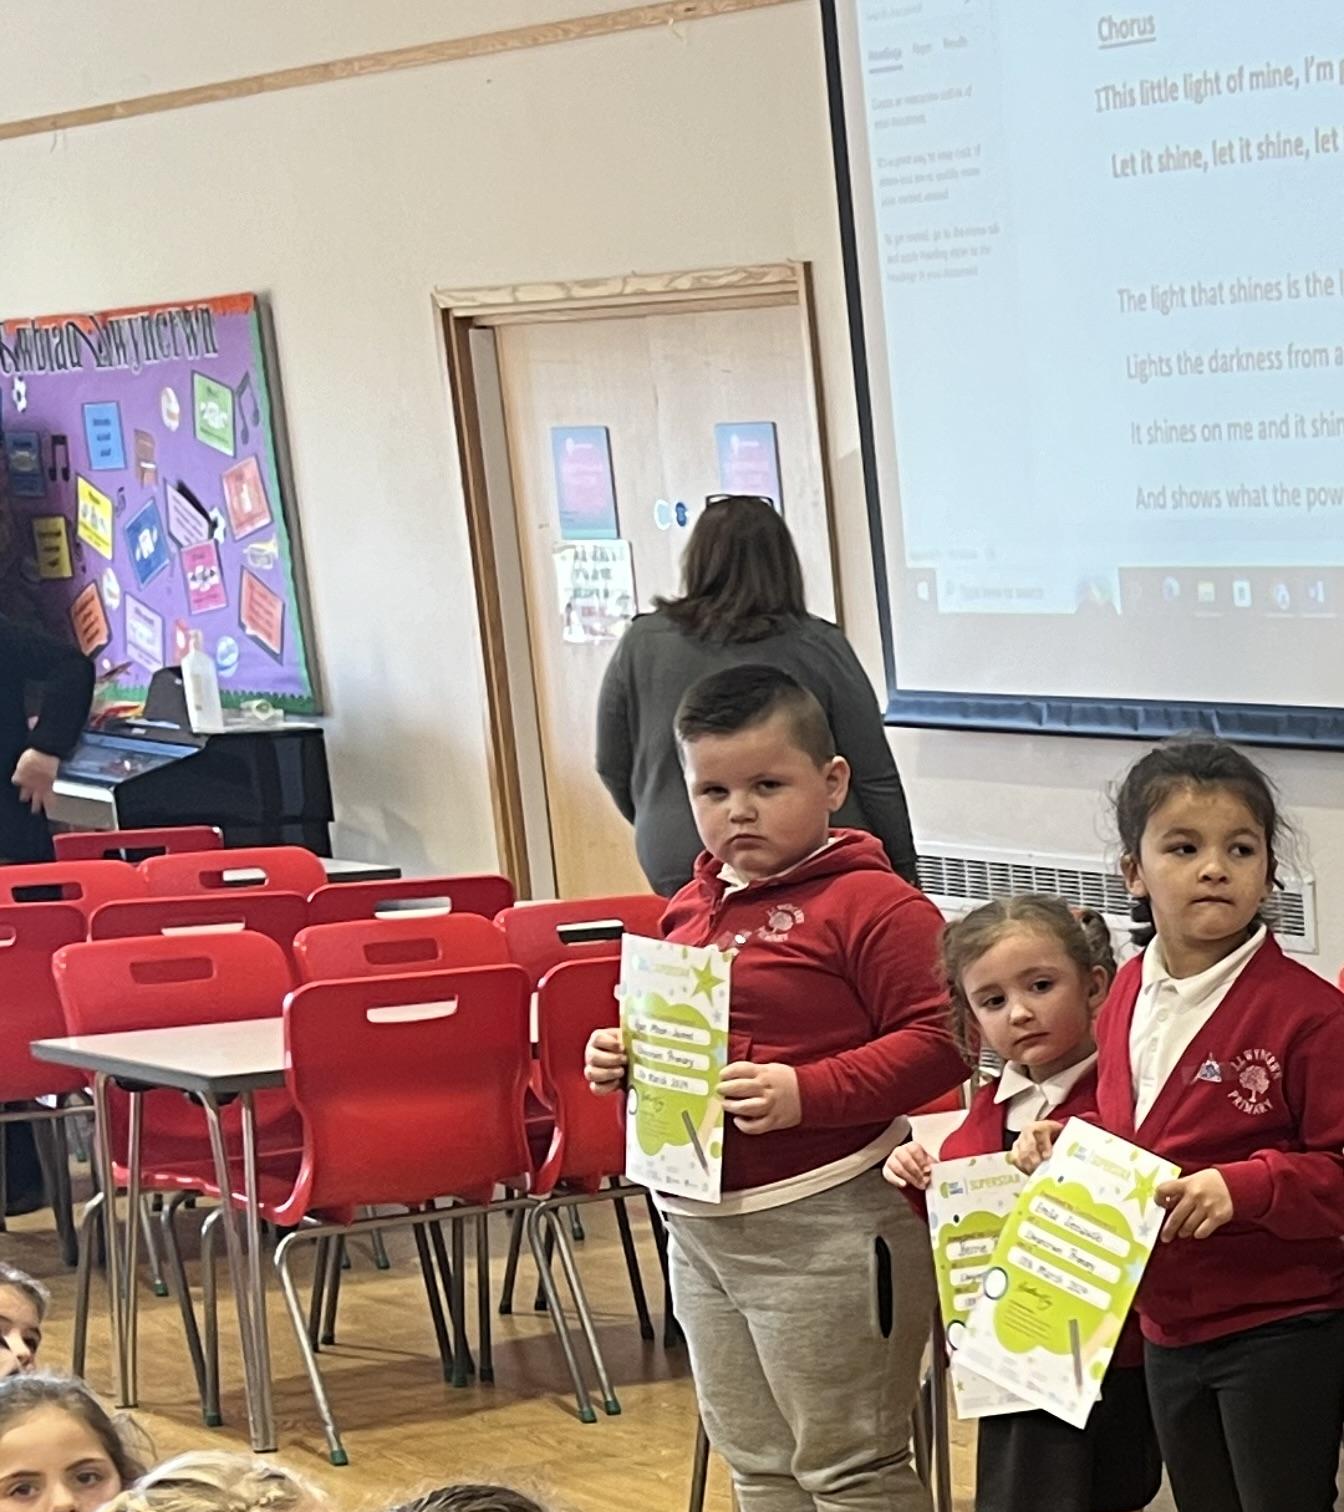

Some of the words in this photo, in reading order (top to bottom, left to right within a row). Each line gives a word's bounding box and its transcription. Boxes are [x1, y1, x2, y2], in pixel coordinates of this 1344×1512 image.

[1098, 14, 1155, 42] Chorus
[1140, 74, 1178, 105] little
[1184, 69, 1221, 104] light
[1227, 66, 1244, 93] of
[1249, 64, 1298, 90] mine,
[1305, 56, 1333, 83] I'm
[1112, 154, 1136, 178] Let
[1141, 149, 1153, 173] it
[1158, 145, 1208, 172] shine,
[1212, 140, 1235, 166] let
[1239, 137, 1252, 163] it
[1257, 133, 1308, 159] shine,
[1314, 128, 1339, 154] let
[1118, 288, 1147, 313] The
[1151, 284, 1185, 315] light
[1191, 280, 1224, 307] that
[1230, 276, 1281, 304] shines
[1287, 273, 1299, 299] is
[1306, 270, 1333, 297] the
[1127, 354, 1172, 384] Lights
[1177, 350, 1204, 376] the
[1209, 347, 1282, 375] darkness
[1288, 342, 1329, 369] from
[1131, 422, 1143, 445] It
[1147, 418, 1196, 444] shines
[1201, 421, 1222, 443] on
[1227, 419, 1253, 441] me
[1258, 413, 1290, 441] and
[1294, 412, 1307, 439] it
[1136, 486, 1167, 510] And
[1171, 484, 1222, 509] shows
[1226, 482, 1267, 508] what
[1272, 481, 1300, 507] the
